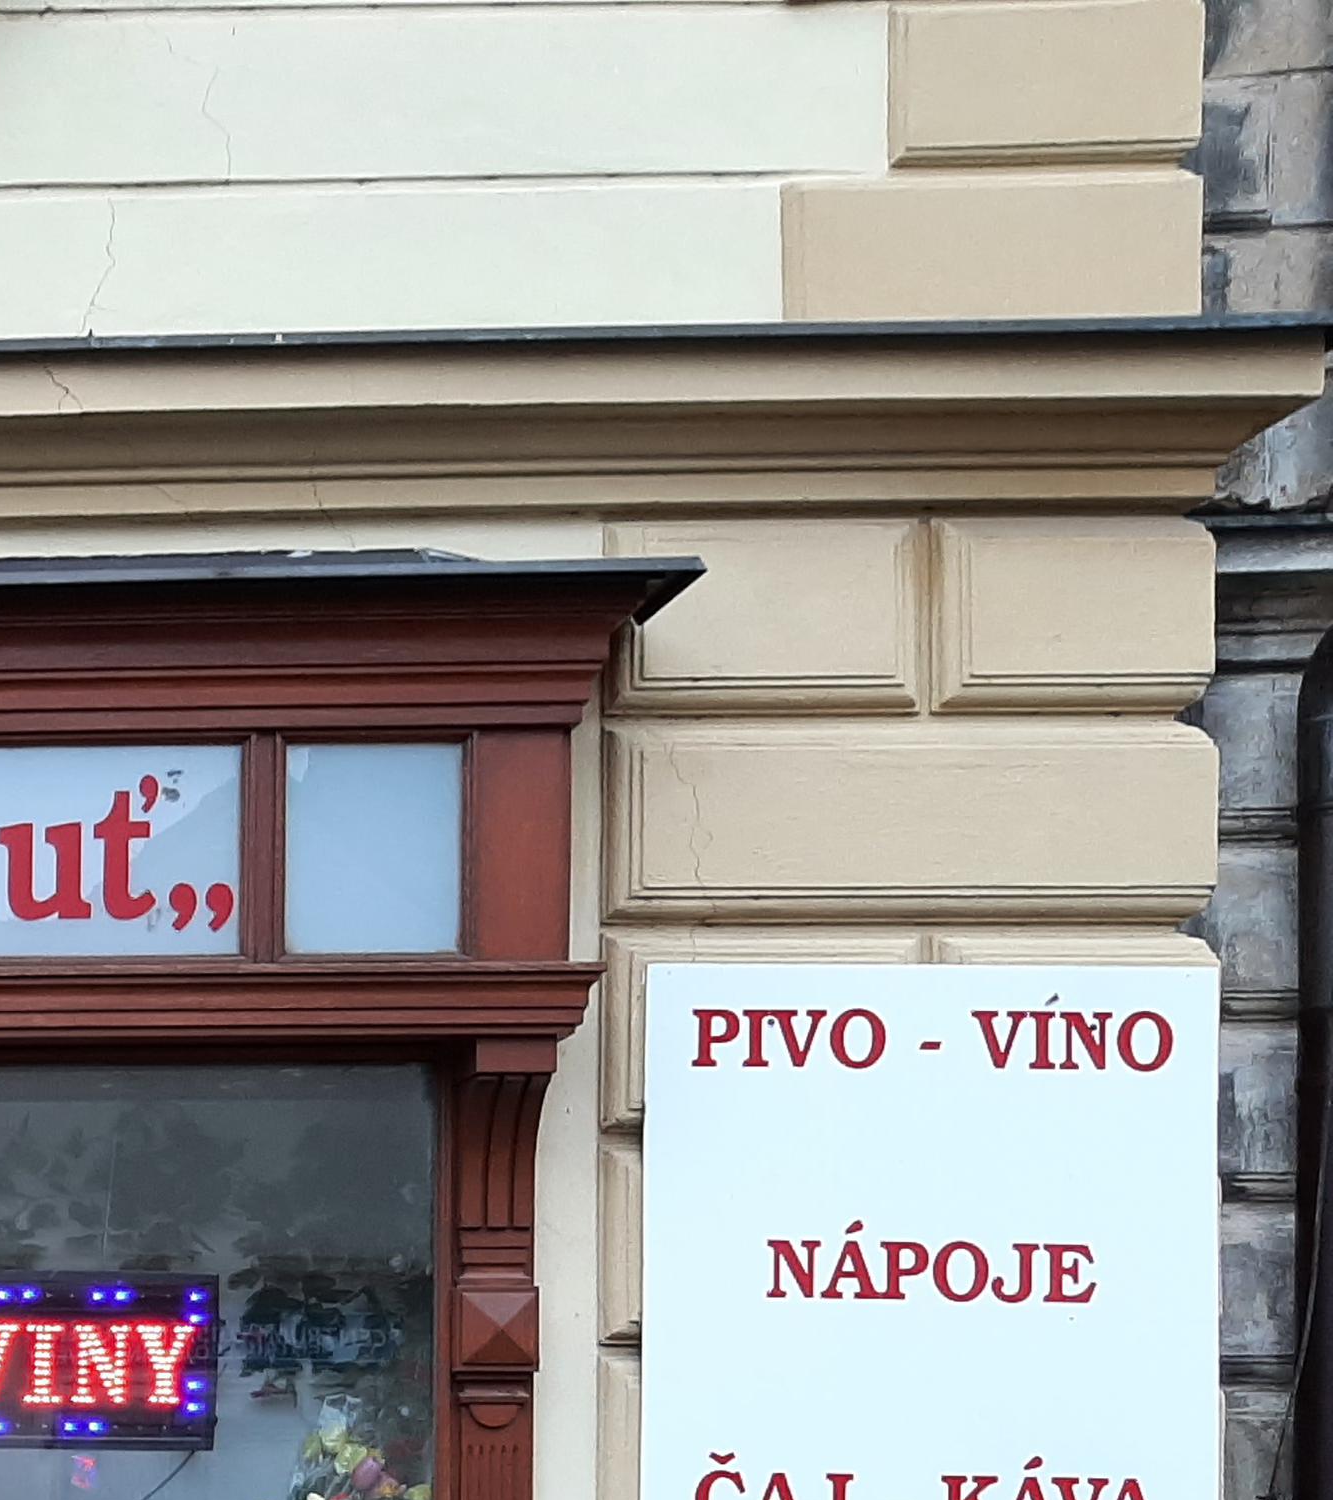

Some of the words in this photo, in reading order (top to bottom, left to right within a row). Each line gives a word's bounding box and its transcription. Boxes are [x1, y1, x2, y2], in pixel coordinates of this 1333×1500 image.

[691, 1008, 888, 1070] PIVO
[971, 994, 1175, 1073] VÍNO
[766, 1220, 1098, 1304] NÁPOJE
